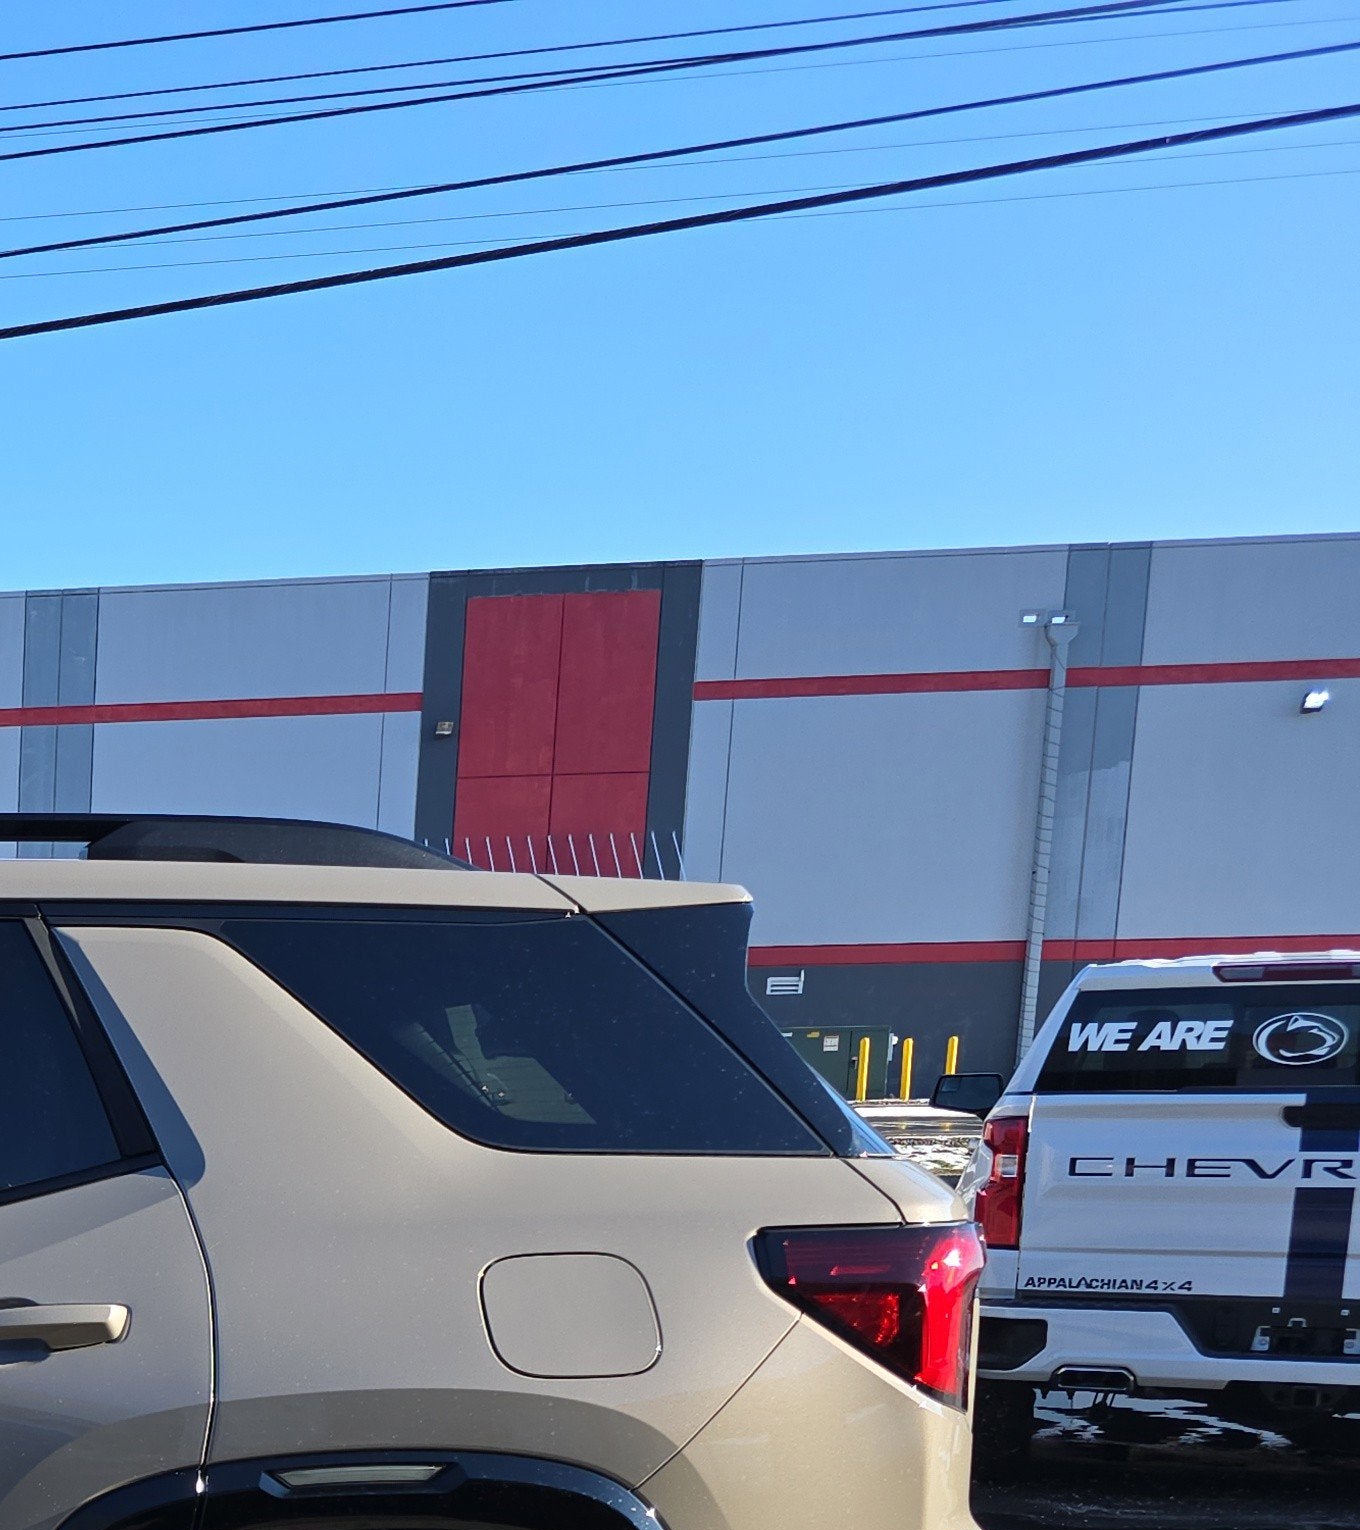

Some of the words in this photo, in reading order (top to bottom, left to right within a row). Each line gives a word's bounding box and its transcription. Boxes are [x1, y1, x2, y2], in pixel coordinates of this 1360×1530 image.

[1067, 1020, 1138, 1053] WE
[1137, 1019, 1234, 1052] ARE
[1068, 1157, 1357, 1180] CHEVR
[1024, 1276, 1143, 1291] APPALACHIAN
